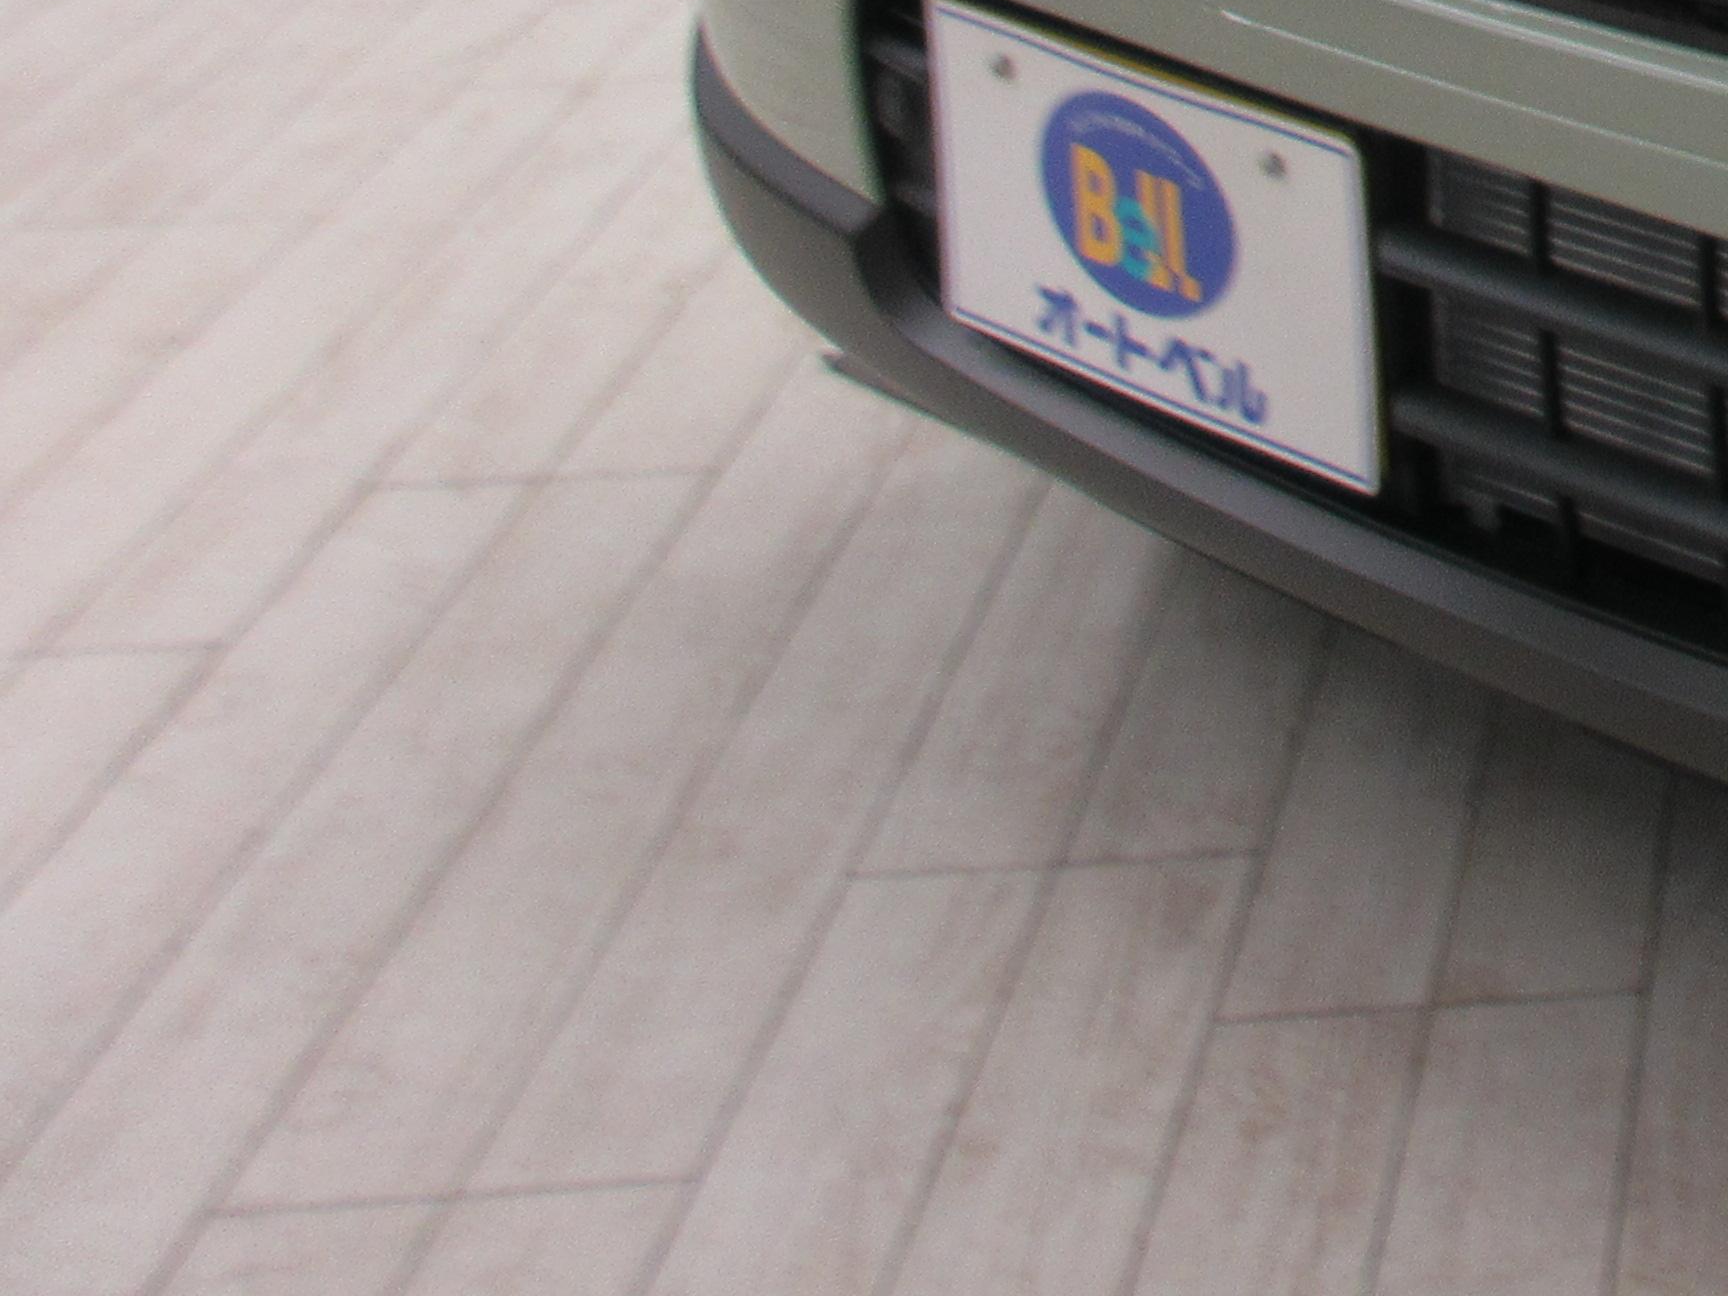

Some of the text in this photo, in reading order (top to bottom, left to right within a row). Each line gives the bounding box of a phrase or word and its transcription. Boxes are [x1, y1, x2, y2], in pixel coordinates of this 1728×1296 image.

[1037, 283, 1267, 425] オートベル
